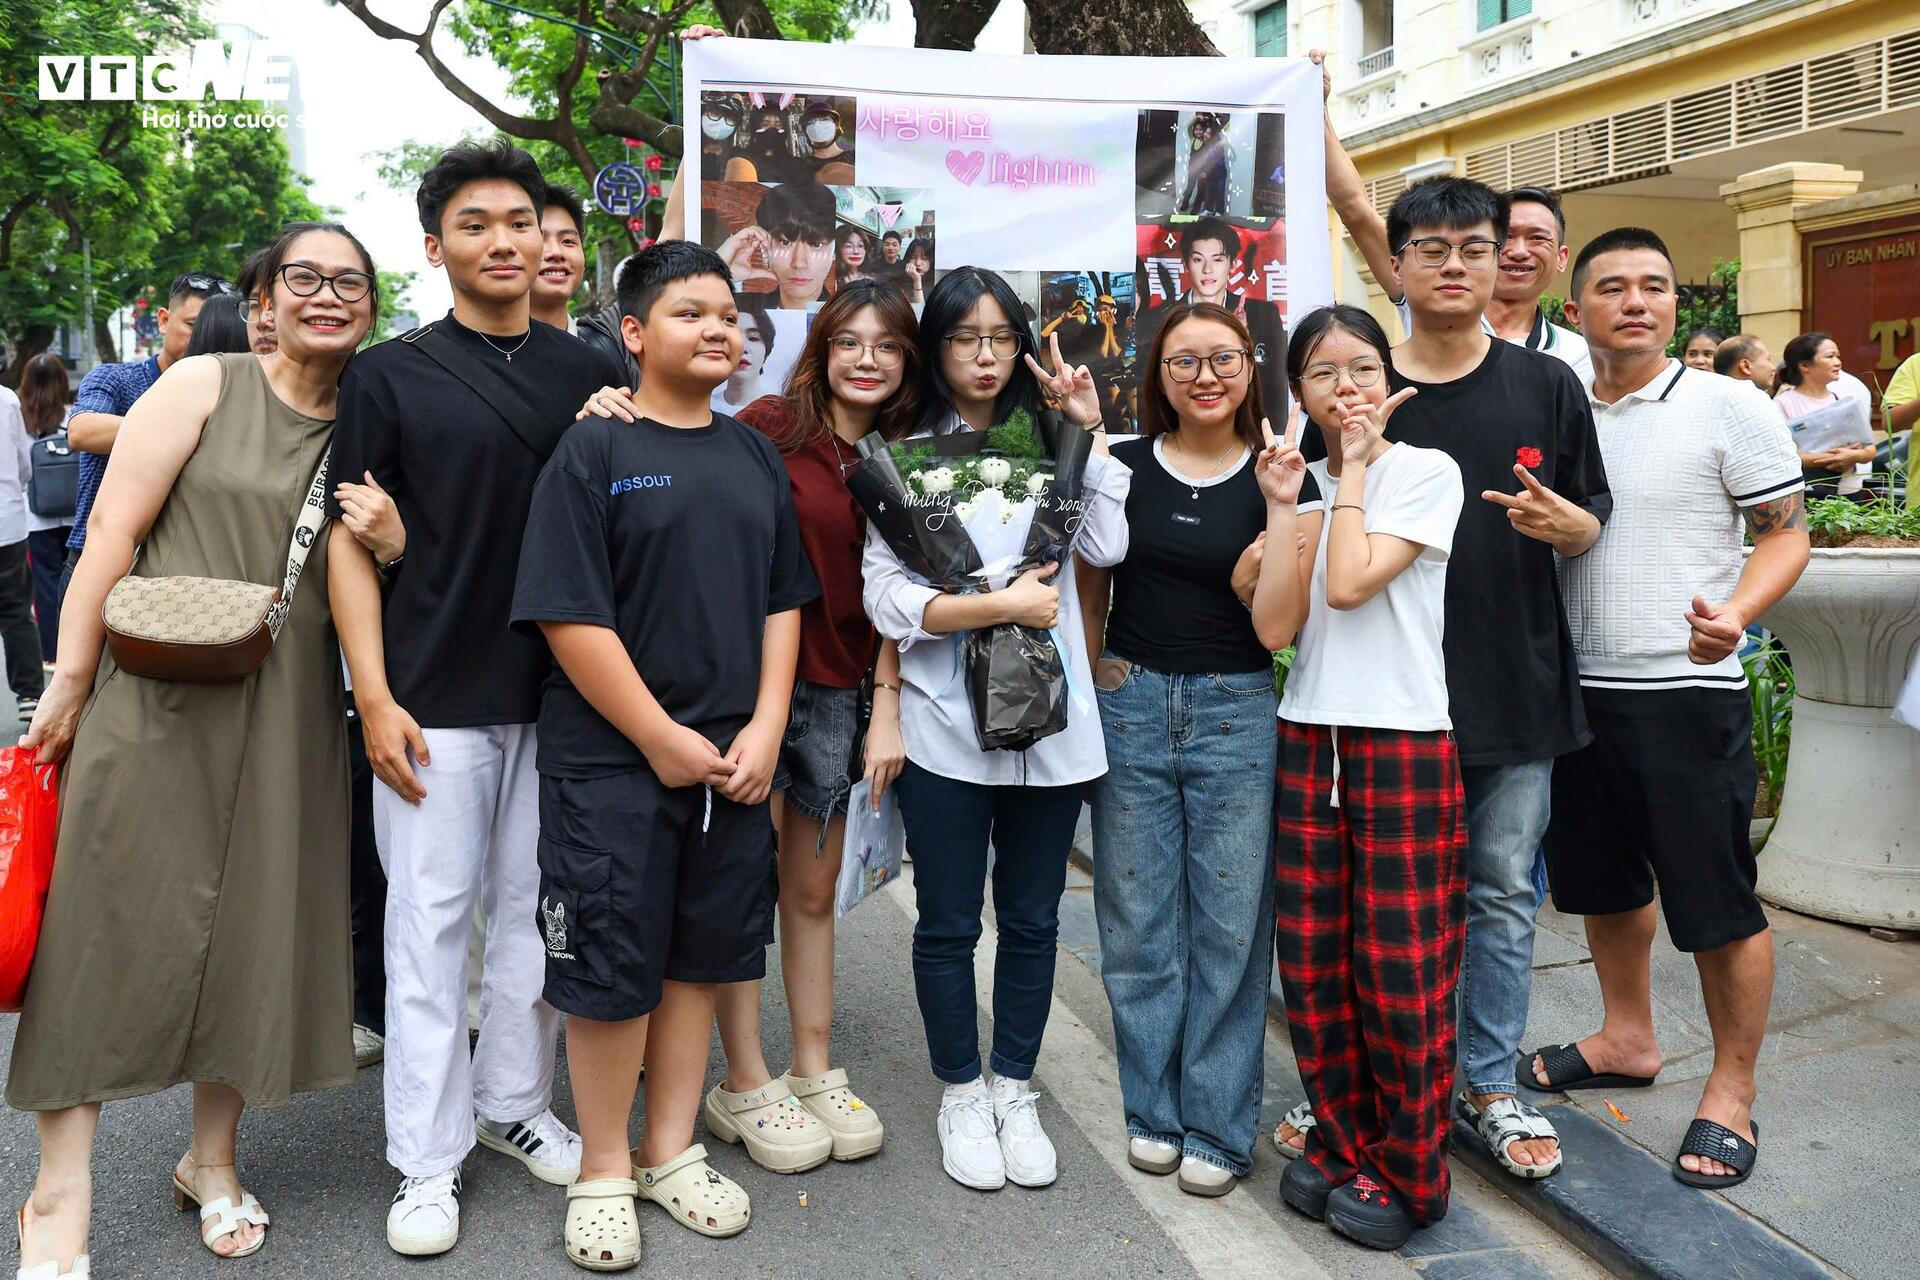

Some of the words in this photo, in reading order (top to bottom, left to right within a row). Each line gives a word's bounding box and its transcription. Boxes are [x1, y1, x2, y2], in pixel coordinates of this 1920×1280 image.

[857, 105, 992, 142] 사랑해요
[1847, 249, 1874, 266] BAN
[1876, 238, 1916, 261] NHÂN
[610, 475, 672, 496] MISSOUT
